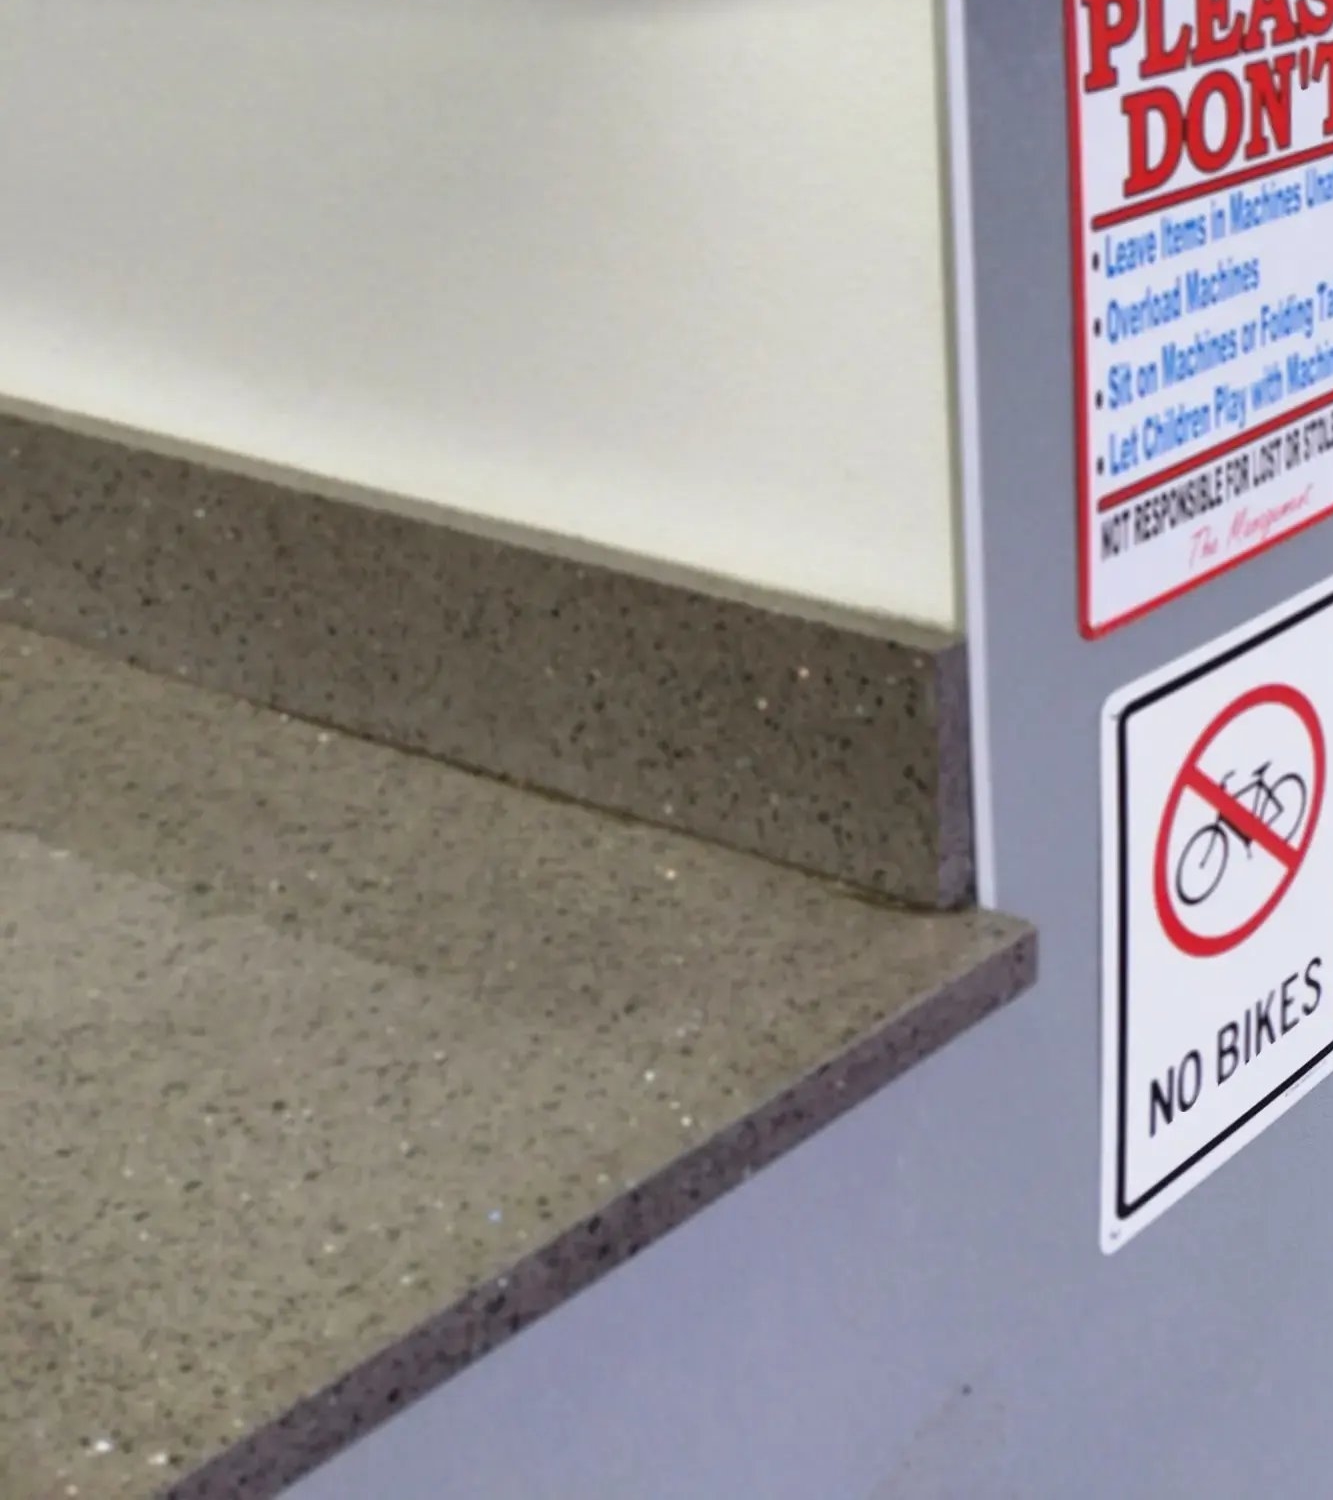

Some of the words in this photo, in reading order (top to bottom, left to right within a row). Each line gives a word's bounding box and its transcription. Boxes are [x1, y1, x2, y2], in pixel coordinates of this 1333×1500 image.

[1104, 229, 1157, 279] Leave
[1160, 213, 1206, 259] Items
[1210, 200, 1225, 242] in
[1229, 181, 1302, 235] Machines
[1106, 276, 1181, 344] Overload
[1185, 257, 1260, 314] Machines
[1108, 361, 1133, 410] Sit
[1136, 361, 1158, 398] on
[1161, 328, 1238, 388] Machines
[1241, 319, 1257, 353] or
[1260, 294, 1314, 347] Folding
[1109, 423, 1140, 476] Let
[1142, 402, 1211, 461] Children
[1214, 383, 1247, 429] Play
[1250, 361, 1283, 411] with
[1101, 509, 1131, 562] NOT
[1133, 465, 1223, 547] RESPONSIBLE
[1226, 452, 1250, 500] FOR
[1253, 437, 1282, 488] LOST
[1285, 427, 1302, 471] OR
[1148, 1049, 1202, 1138] NO
[1215, 956, 1323, 1087] BIKES
